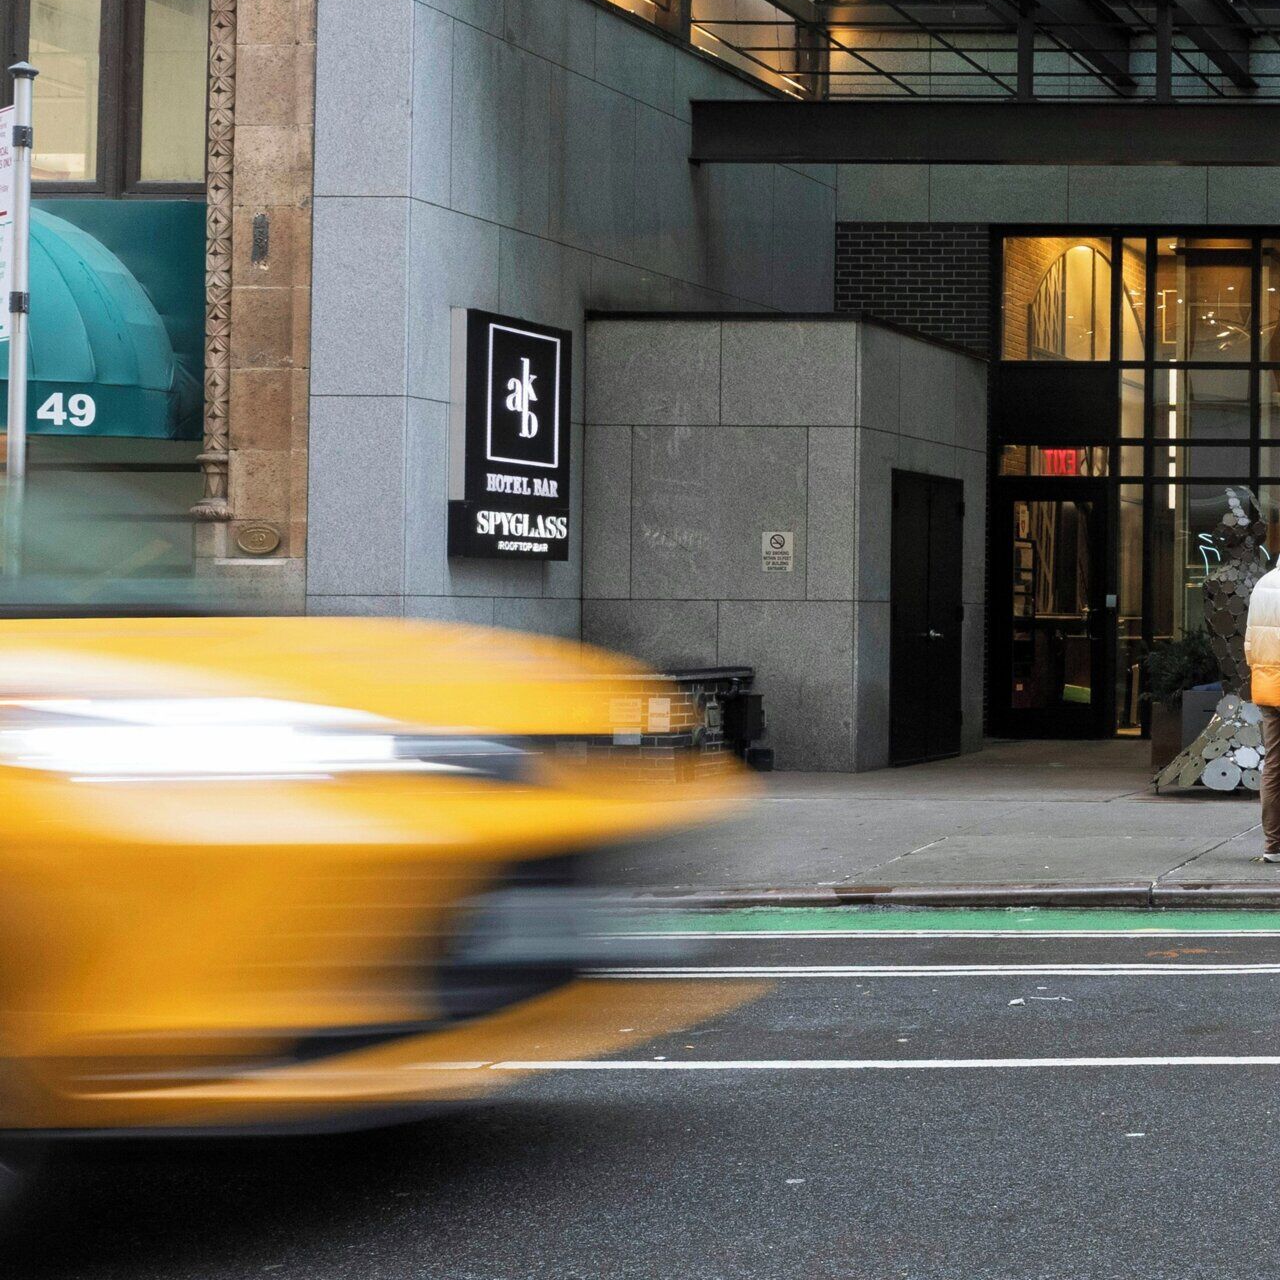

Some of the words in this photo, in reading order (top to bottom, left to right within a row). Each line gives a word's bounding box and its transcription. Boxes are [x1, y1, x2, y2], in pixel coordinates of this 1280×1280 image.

[36, 392, 96, 427] 49
[486, 473, 531, 496] HOTEL
[533, 477, 559, 498] BAR
[476, 510, 567, 539] SPYGLASS
[498, 540, 532, 552] ROOFTOP
[532, 542, 548, 552] BAR
